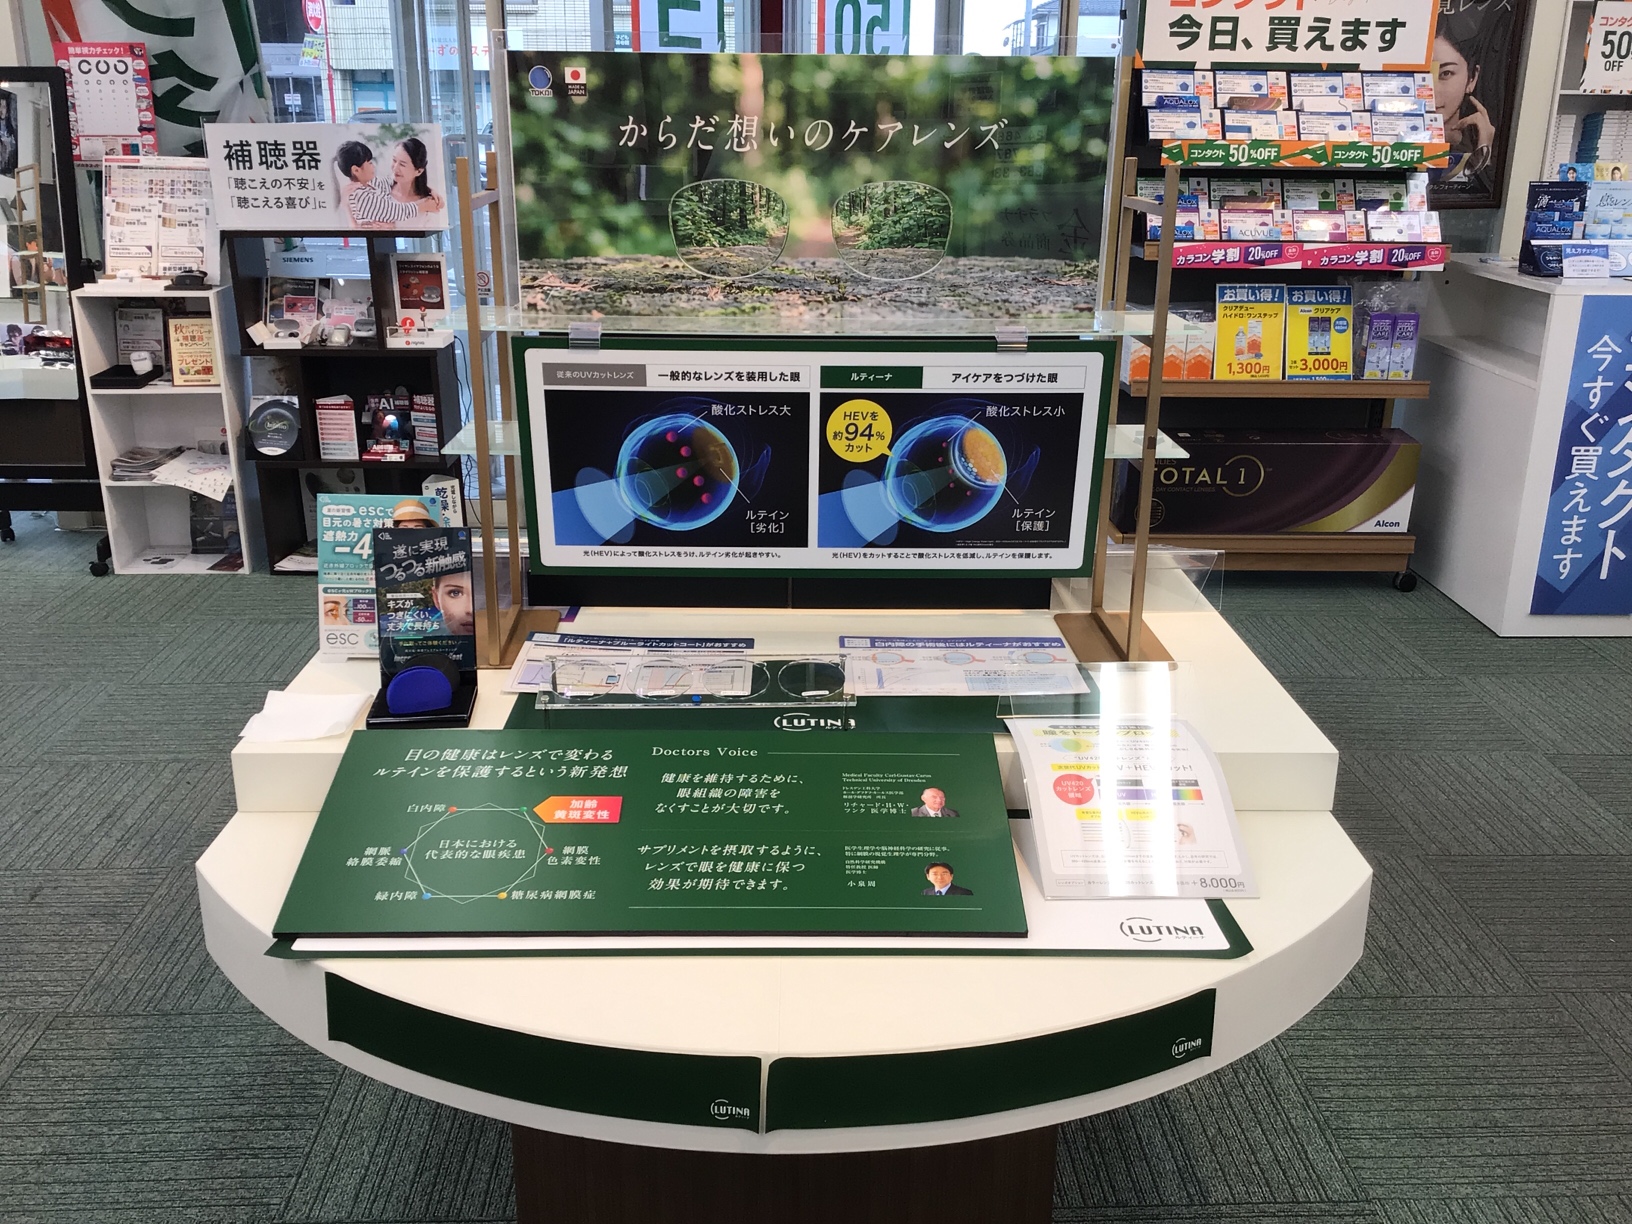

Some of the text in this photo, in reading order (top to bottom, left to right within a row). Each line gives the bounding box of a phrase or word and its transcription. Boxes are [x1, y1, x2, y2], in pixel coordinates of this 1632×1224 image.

[1168, 13, 1407, 52] 今日、買えます
[1604, 60, 1624, 72] OFF
[617, 114, 1009, 152] からだ想いのケアレンズ
[222, 139, 322, 171] 補聴器
[1190, 149, 1226, 158] コンタクト
[1333, 150, 1369, 159] コンタクト
[228, 177, 325, 191] 「聴こえの不安」を
[230, 195, 327, 210] 「聴こえる喜び」に
[1238, 229, 1275, 238] ACUVUE
[1223, 288, 1280, 302] お買い得!
[1291, 289, 1346, 303] お買い得!
[177, 358, 213, 366] プレゼント!
[1299, 357, 1348, 373] 3,000円
[556, 370, 635, 380] 従来のUVカットレンズ
[1226, 362, 1271, 376] 1,300円
[657, 370, 801, 383] 一般的なレンズを装用した眼
[850, 372, 893, 382] ルティーナ
[951, 372, 1059, 384] アイケアをつづけた眼
[378, 397, 395, 411] AI
[710, 404, 792, 417] 酸化ストレス大
[843, 410, 879, 421] HEVを
[985, 405, 1066, 418] 酸化ストレス小
[832, 422, 886, 442] 約94%
[844, 443, 873, 453] カット
[1552, 334, 1623, 581] 今すぐ買えます
[745, 510, 790, 521] ルテイン
[1011, 508, 1056, 518] ルテイン
[322, 518, 395, 528] 目元の暑さ対策
[1374, 520, 1401, 529] Alcon
[322, 531, 358, 542] 遮熱力
[392, 536, 449, 560] 遂に実現
[386, 599, 414, 609] キズが
[326, 632, 360, 646] esc
[404, 748, 614, 762] 目の健康はレンズで変わる
[651, 746, 759, 757] Doctors Voice
[372, 765, 629, 779] ルテインを保護するという新発想
[660, 772, 805, 784] 健康を維持するために、
[676, 787, 781, 799] 眼組織の障害を
[406, 803, 447, 814] 白内障
[569, 799, 598, 809] 加齢
[654, 802, 790, 815] なくすことが大切です。
[553, 809, 611, 820] 黄斑変性
[438, 839, 518, 849] 日本における
[562, 845, 589, 855] 網膜
[637, 844, 822, 856] サプリメントを摂取するように、
[424, 849, 526, 860] 代表的な眼疾患
[546, 855, 602, 866] 色素変性
[644, 860, 806, 873] レンズで眼を健康に保つ
[647, 877, 790, 891] 効果が期待できます。
[373, 891, 418, 901] 緑内障
[510, 889, 597, 900] 糖尿病網膜症
[1127, 925, 1205, 936] LUTINA
[1174, 1037, 1202, 1054] LUTINA
[714, 1105, 750, 1117] LUTINA
